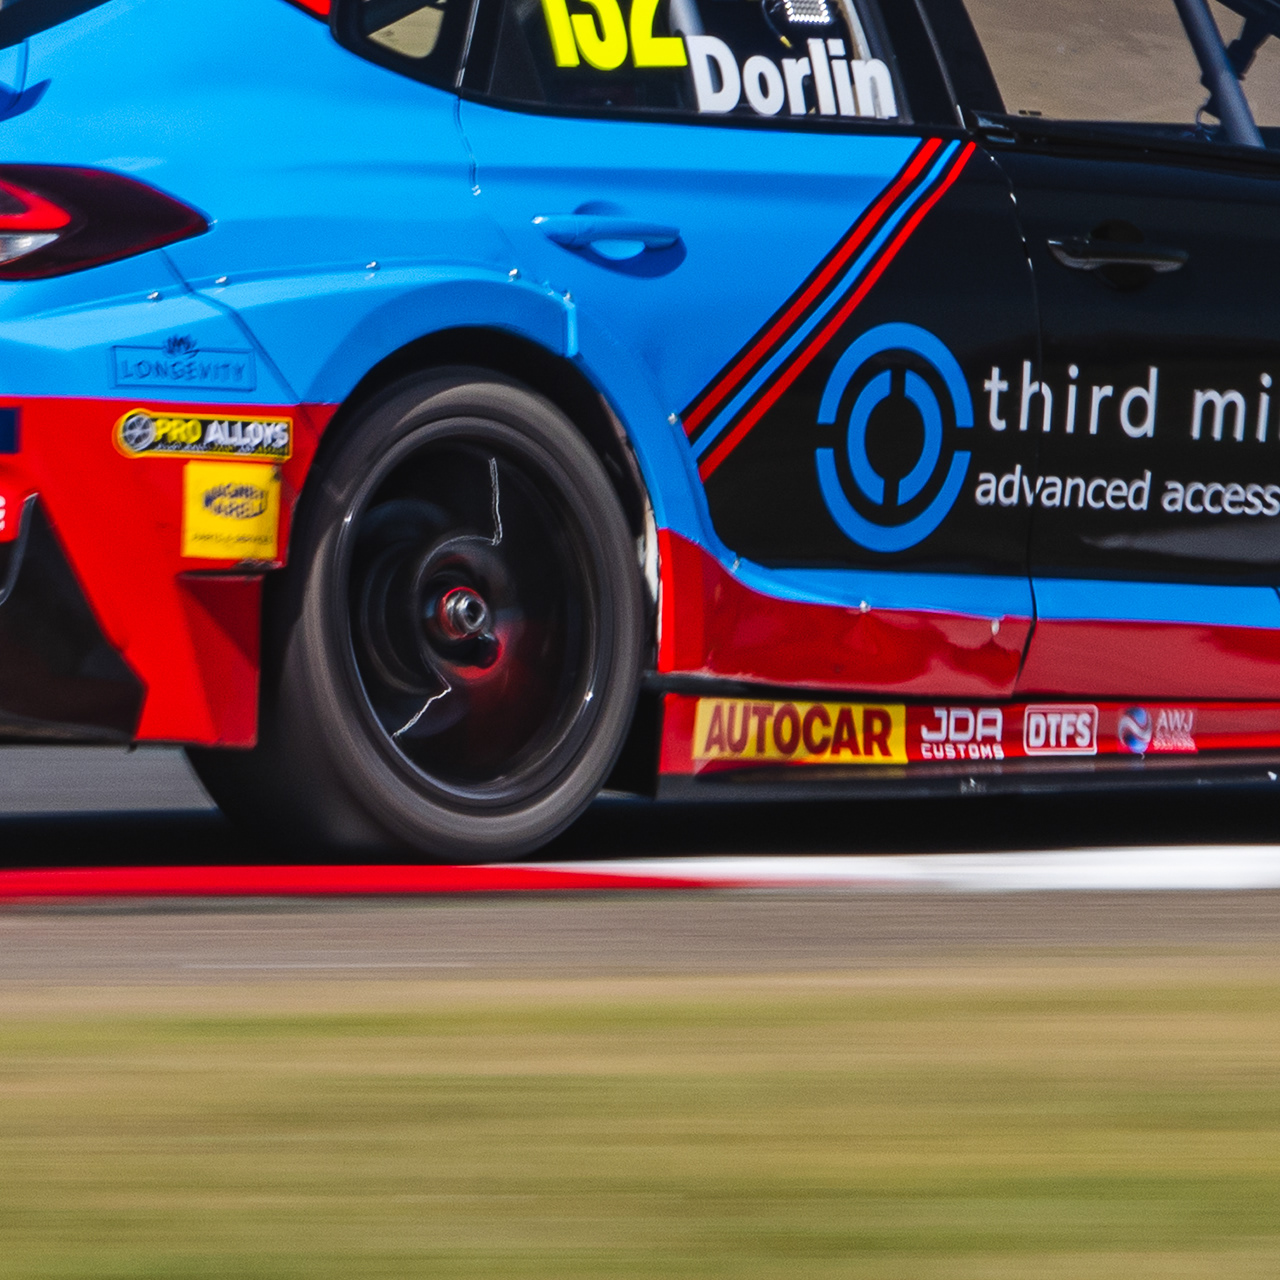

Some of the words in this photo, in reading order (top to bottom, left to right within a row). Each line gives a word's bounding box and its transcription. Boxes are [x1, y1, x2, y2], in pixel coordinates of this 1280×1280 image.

[686, 34, 898, 119] Dorlin
[121, 359, 246, 383] LONGEVITY
[983, 360, 1159, 439] third
[153, 417, 203, 444] PRO
[204, 419, 289, 449] ALLOYS
[975, 464, 1152, 513] advanced
[703, 700, 894, 758] AUTOCAR
[921, 705, 1004, 742] JDA
[1029, 712, 1092, 748] DTFS
[921, 742, 1005, 760] CUSTOMS
